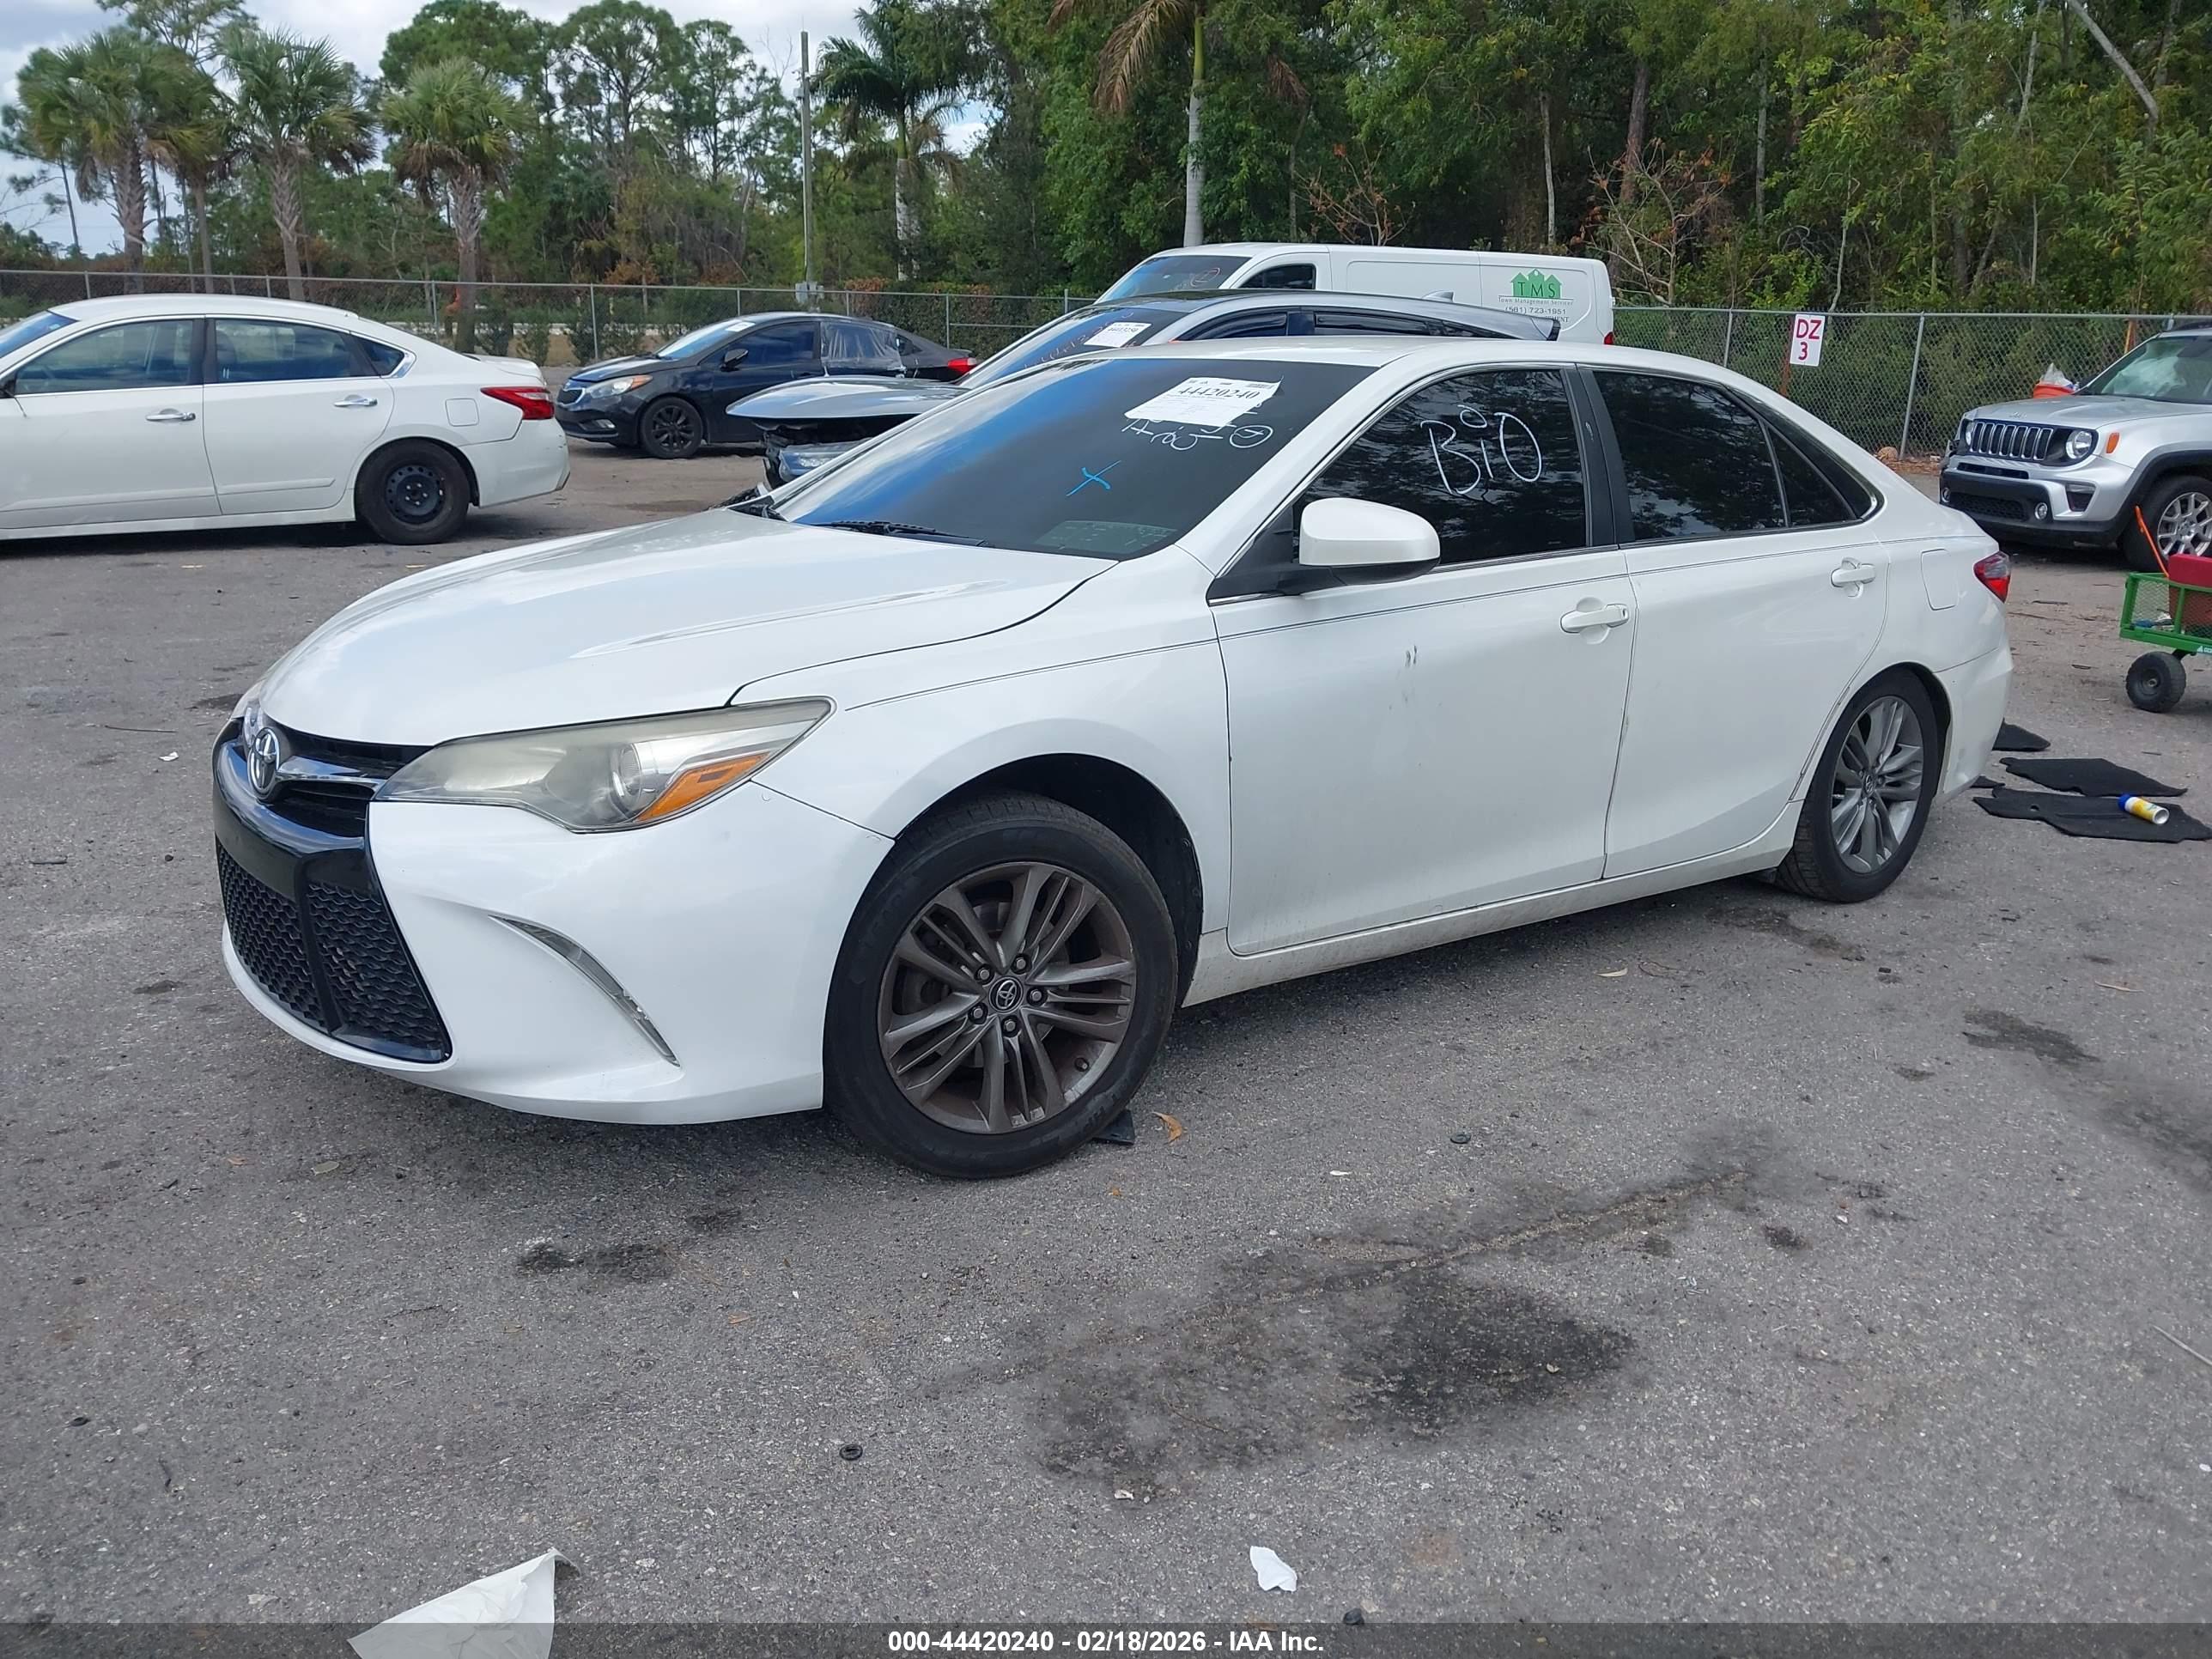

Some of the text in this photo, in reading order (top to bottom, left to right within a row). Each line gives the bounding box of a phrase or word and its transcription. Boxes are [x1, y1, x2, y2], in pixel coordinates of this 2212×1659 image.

[1517, 281, 1556, 298] TMS
[1529, 307, 1566, 315] 723-1951
[1796, 319, 1822, 339] DZ
[1798, 341, 1808, 361] 3
[1177, 386, 1260, 399] 44420240
